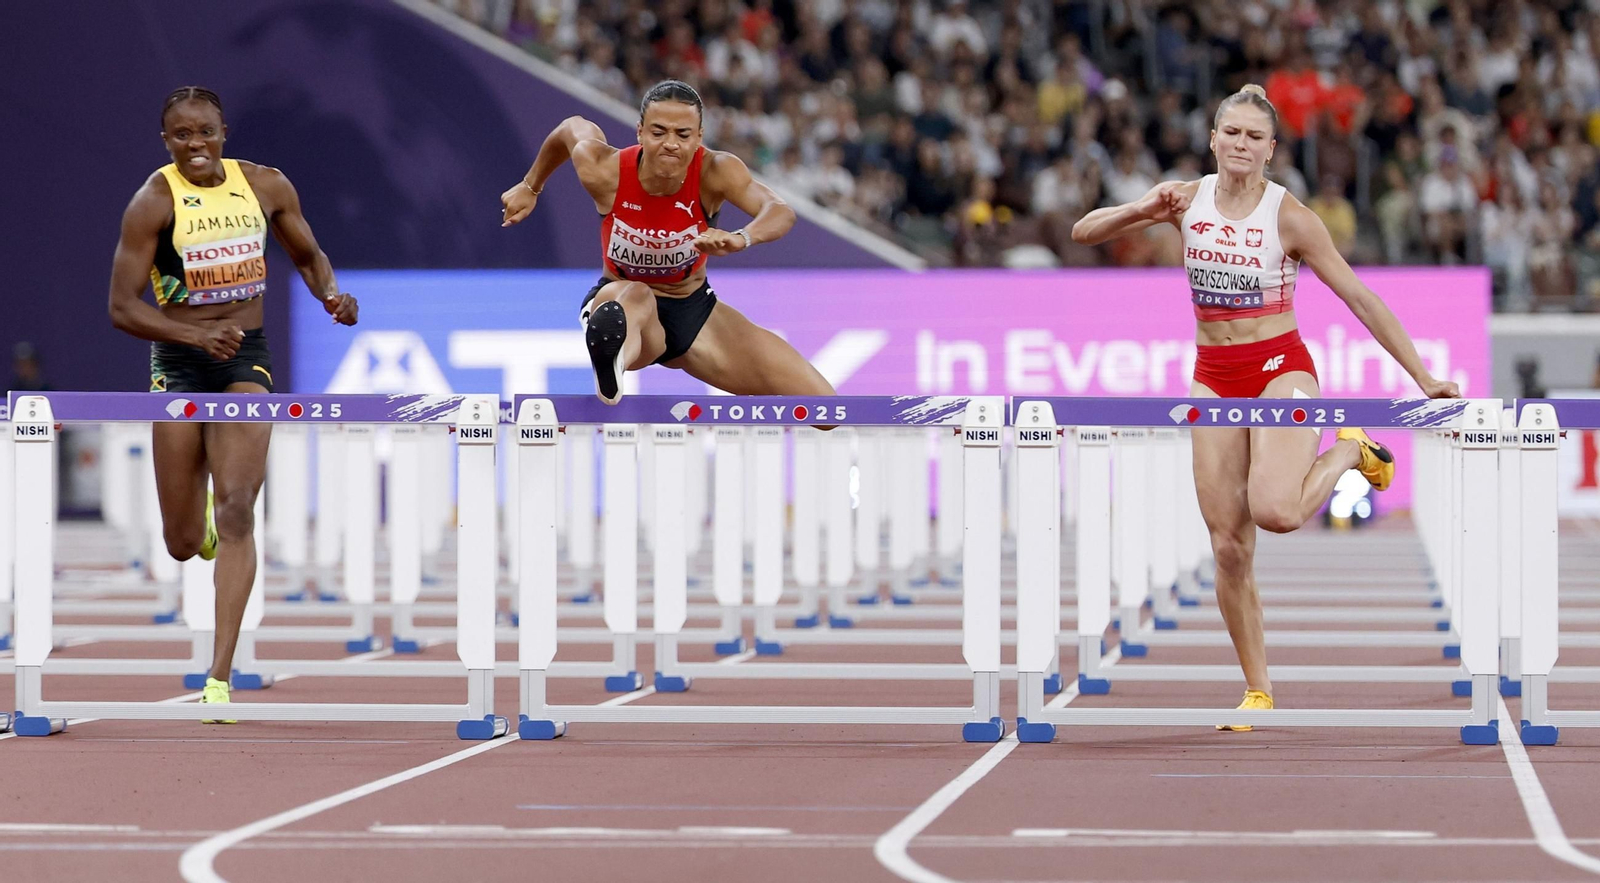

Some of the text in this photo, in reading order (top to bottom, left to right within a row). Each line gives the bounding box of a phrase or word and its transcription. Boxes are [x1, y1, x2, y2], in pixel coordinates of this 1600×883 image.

[186, 215, 261, 235] JAMAICA
[1190, 221, 1215, 234] 4F
[614, 224, 696, 249] HONDA
[1215, 238, 1237, 247] ORLEN
[185, 240, 261, 262] HONDA
[1186, 246, 1264, 269] HONDA
[190, 258, 264, 288] WILLIAMS
[916, 329, 988, 393] In
[1261, 354, 1285, 372] 4F
[16, 426, 48, 436] NISHI
[460, 428, 493, 438] NISHI
[521, 429, 553, 439] NISHI
[966, 431, 998, 441] NISHI
[1019, 431, 1052, 441] NISHI
[1465, 433, 1497, 443] NISHI
[1523, 434, 1555, 443] NISHI
